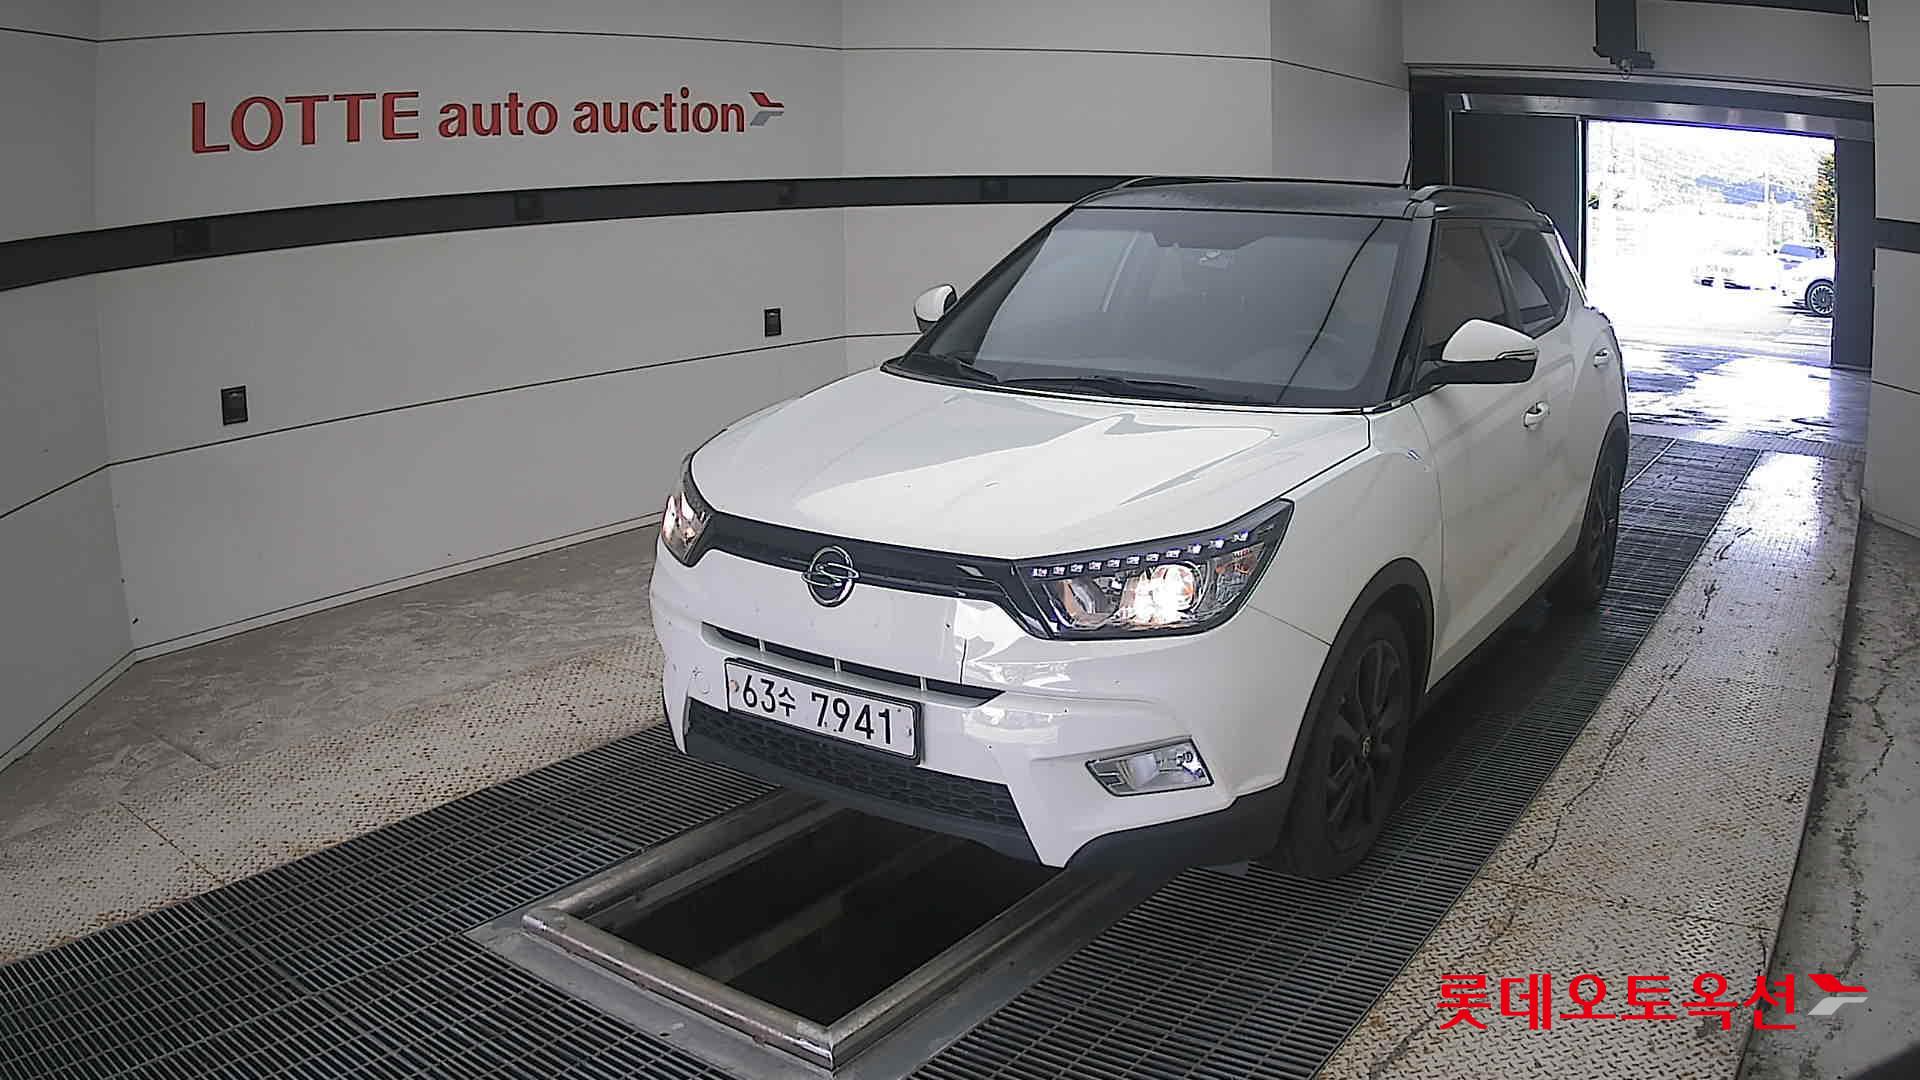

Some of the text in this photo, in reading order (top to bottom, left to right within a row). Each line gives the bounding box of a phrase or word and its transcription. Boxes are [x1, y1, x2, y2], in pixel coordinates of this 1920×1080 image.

[192, 87, 745, 154] LOTTE auto auction
[742, 675, 891, 744] 63수 7941
